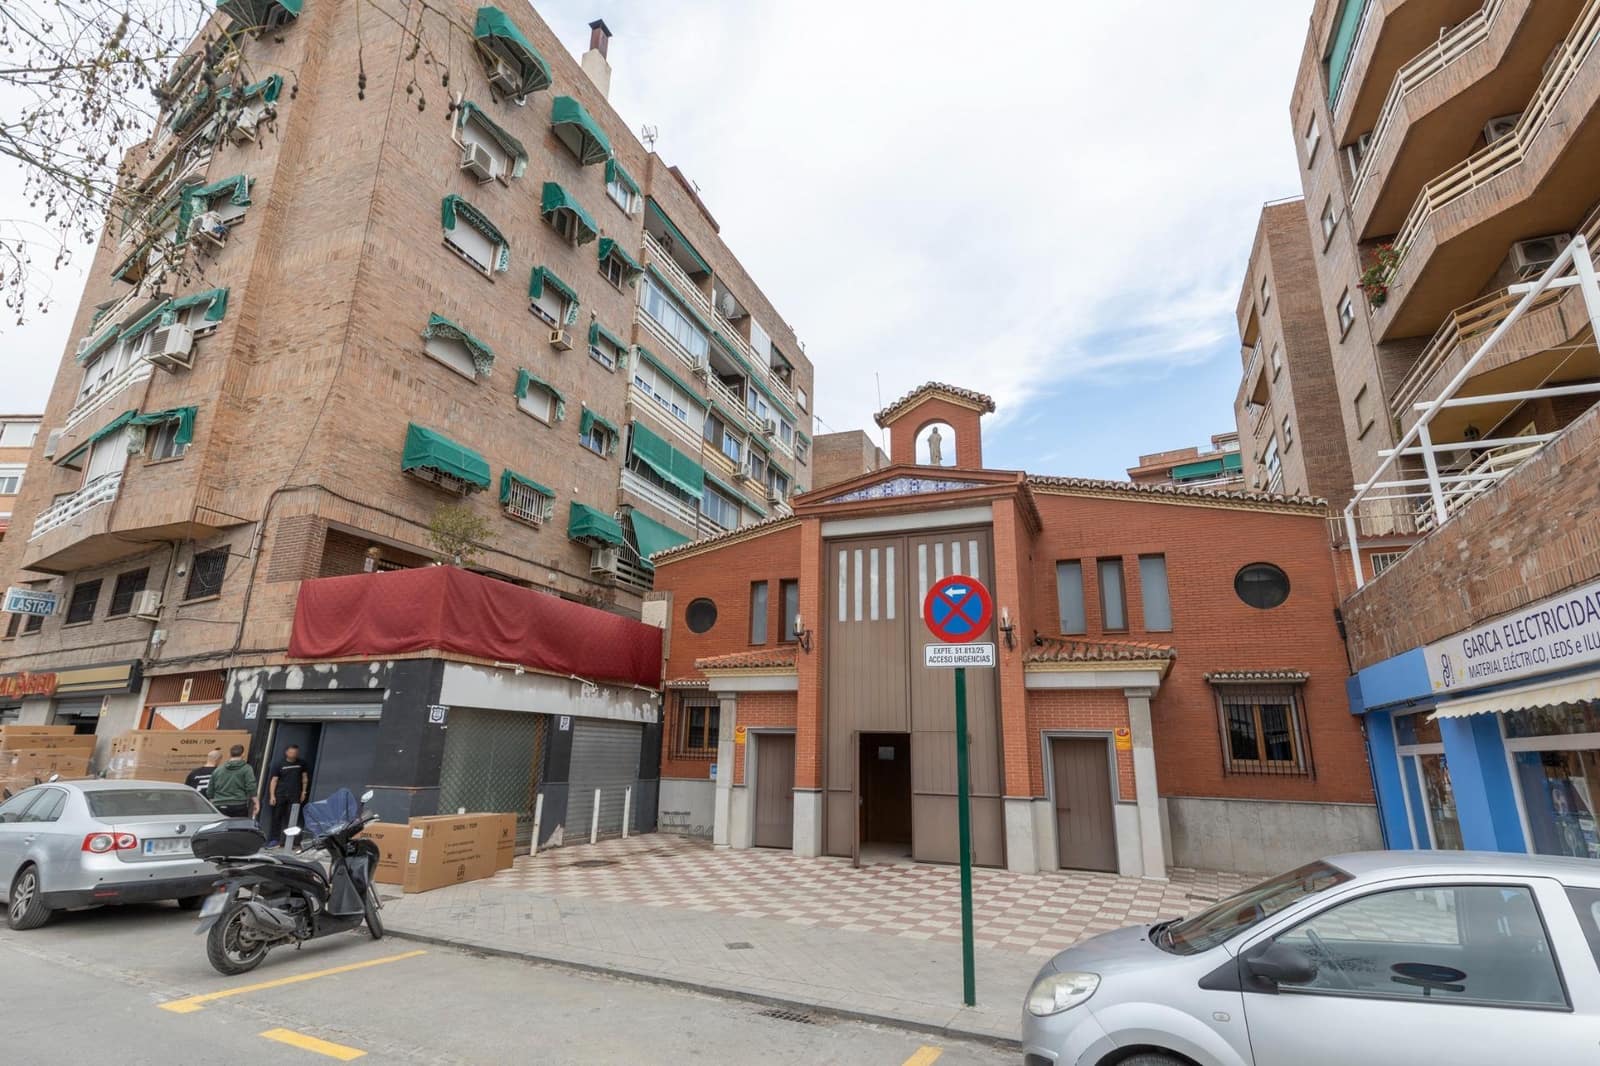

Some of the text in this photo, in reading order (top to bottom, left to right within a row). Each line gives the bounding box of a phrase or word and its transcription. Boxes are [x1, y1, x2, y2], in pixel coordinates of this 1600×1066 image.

[10, 597, 53, 614] LASTRA
[1462, 629, 1503, 659] GARCA
[928, 654, 991, 663] ACCESO URGENCIAS
[1468, 657, 1503, 679] MATERIAL
[1502, 645, 1549, 672] ELÉCTRICO,
[1548, 638, 1574, 660] LEDS
[1575, 641, 1583, 653] e
